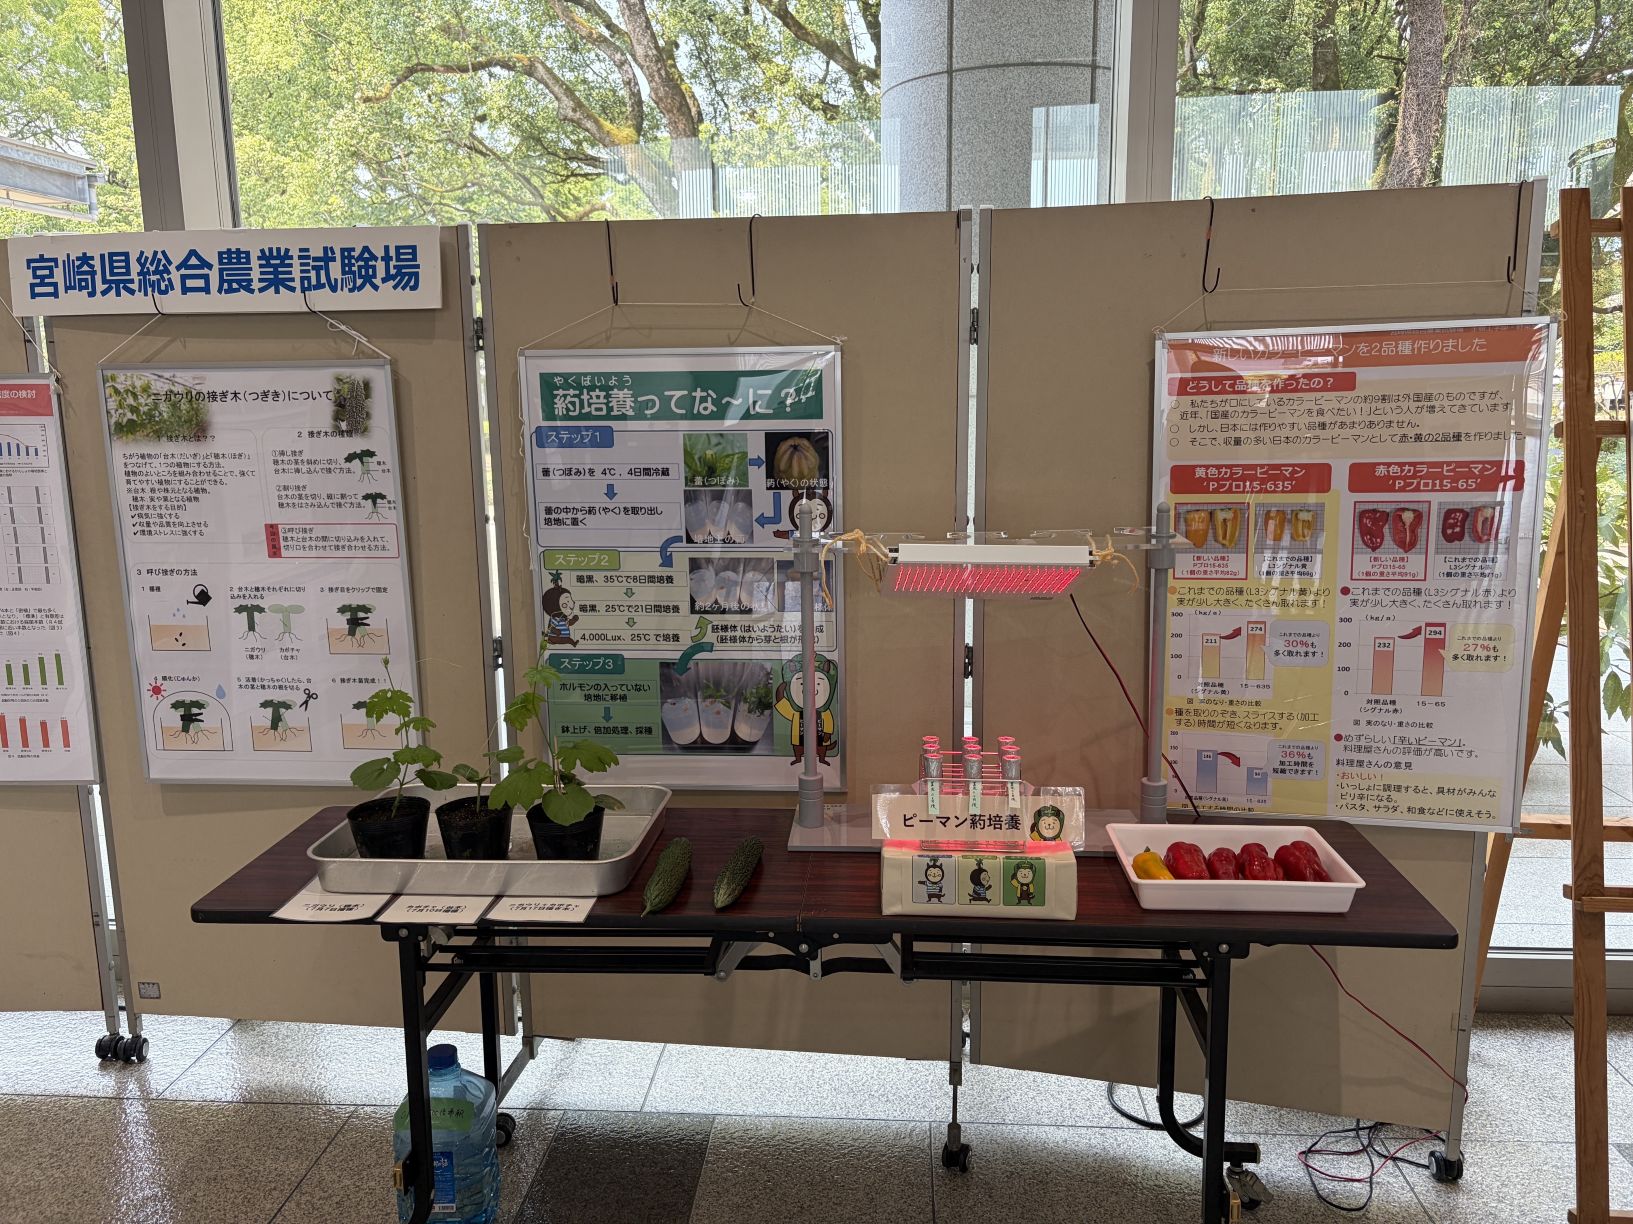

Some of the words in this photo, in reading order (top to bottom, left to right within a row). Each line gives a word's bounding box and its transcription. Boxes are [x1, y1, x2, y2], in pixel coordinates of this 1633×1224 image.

[26, 244, 421, 299] 宮崎県総合農業試験場
[554, 375, 632, 386] やくばいよう
[152, 388, 333, 404] ニガウリの接ぎ木（つぎき）について
[547, 431, 600, 443] ステップ1
[1194, 466, 1305, 478] 黄色カラーピーマン
[1375, 463, 1497, 476] 赤色カラーピーマン
[544, 516, 587, 527] 培地に置く
[555, 554, 609, 566] ステップ2
[560, 658, 614, 669] ステップ3
[560, 683, 650, 692] ホルモンの入っていない
[1335, 759, 1413, 770] 料理屋さんの意見
[903, 813, 1022, 830] ピーマン葯培養
